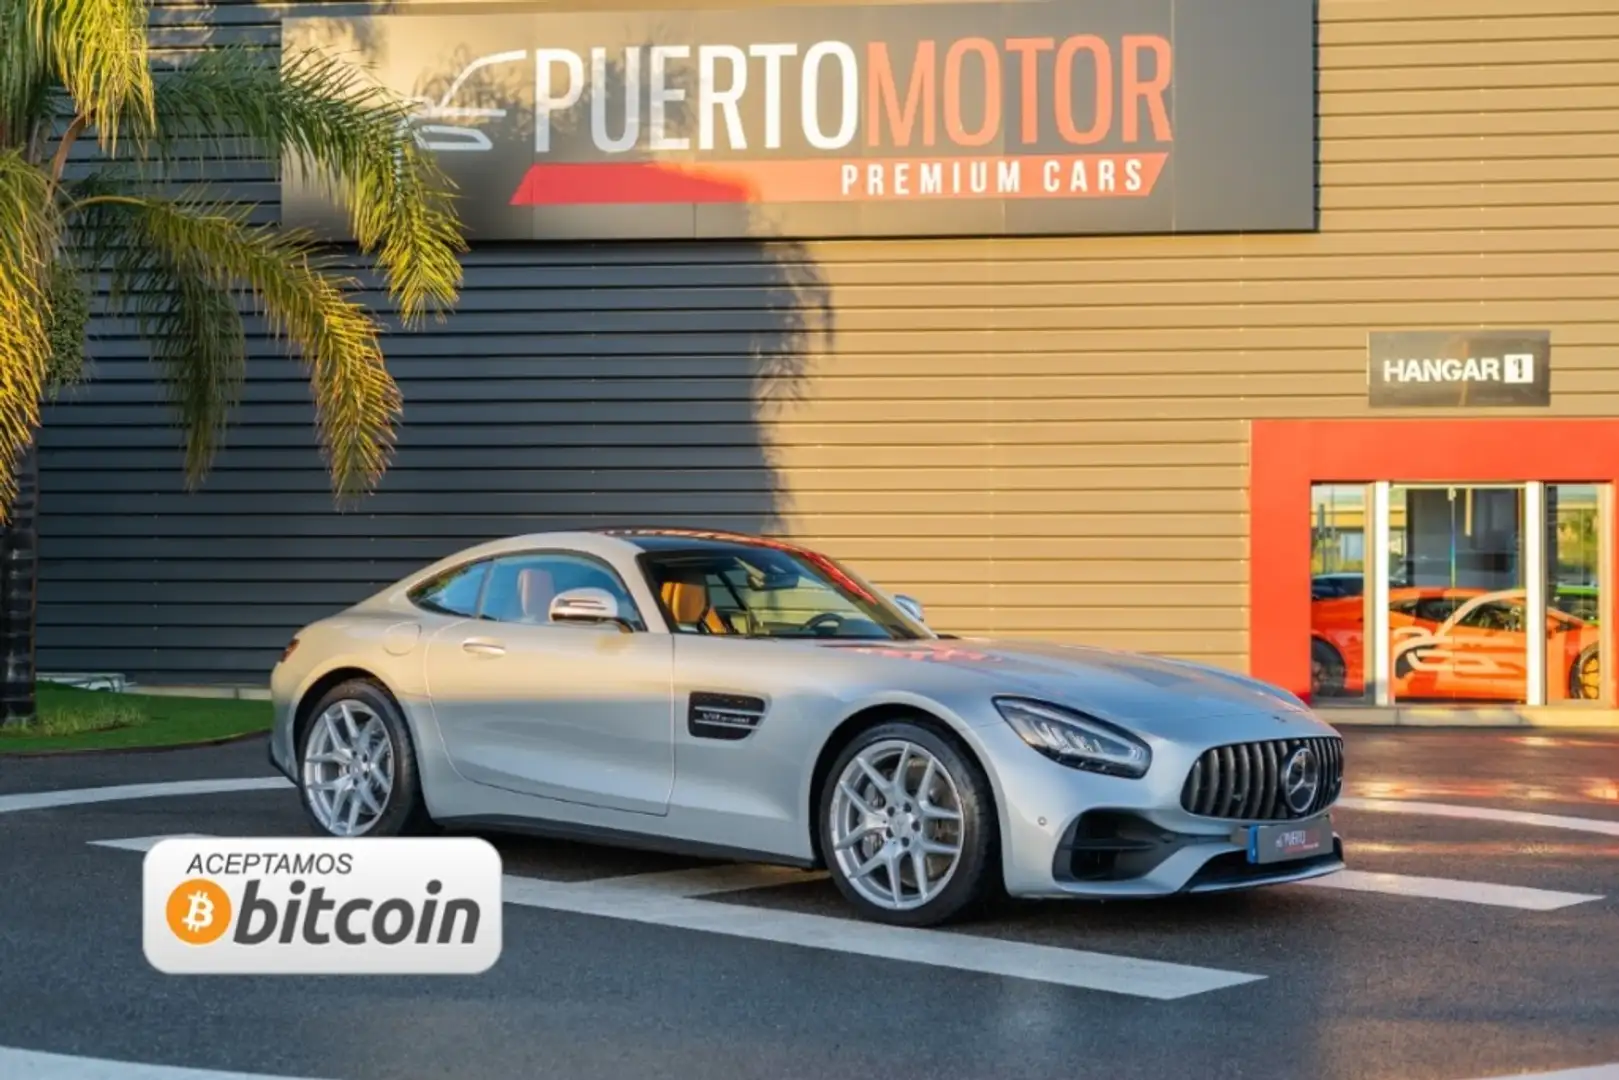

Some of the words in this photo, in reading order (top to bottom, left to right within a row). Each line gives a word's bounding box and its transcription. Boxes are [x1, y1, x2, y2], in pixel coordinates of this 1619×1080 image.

[841, 160, 1022, 197] PREMIUM
[1042, 158, 1143, 193] CARS
[1383, 357, 1501, 383] HANGAR
